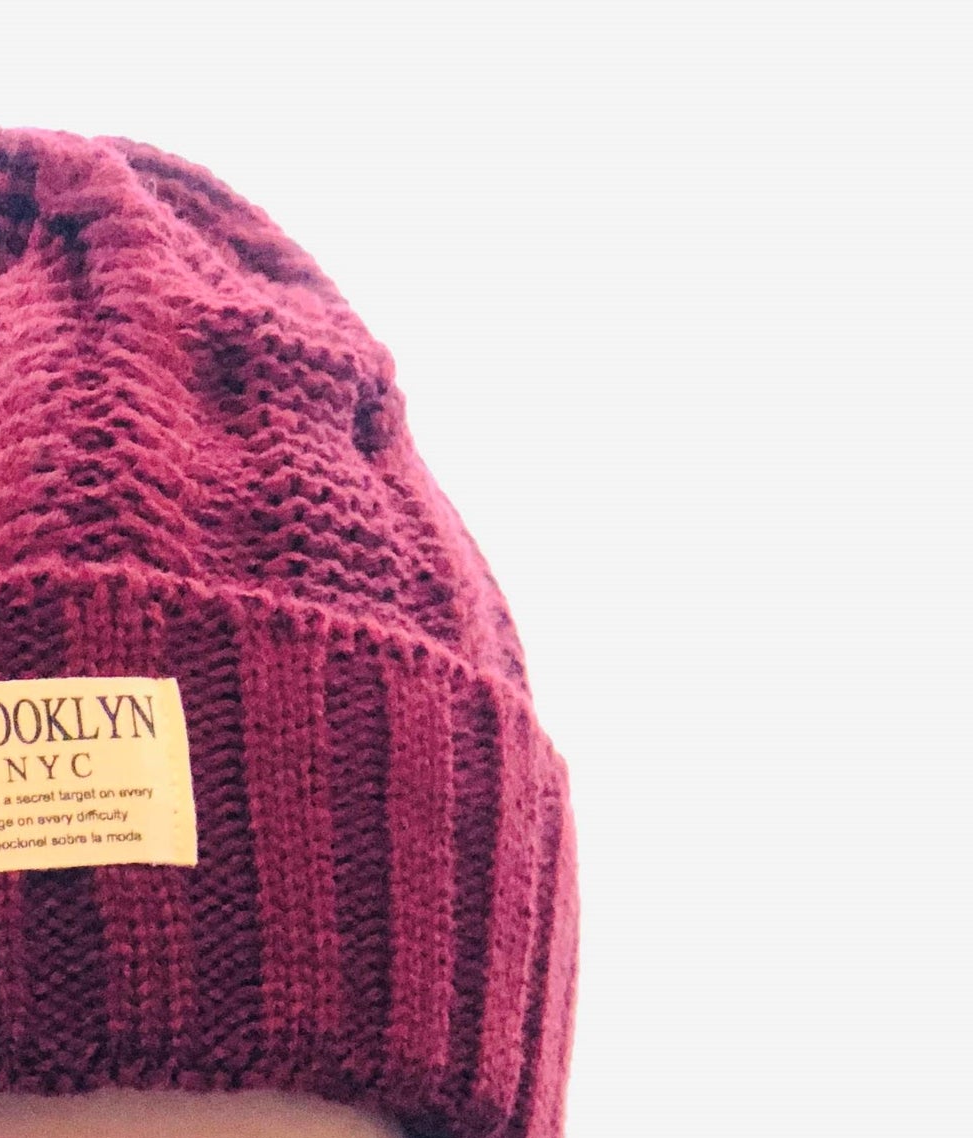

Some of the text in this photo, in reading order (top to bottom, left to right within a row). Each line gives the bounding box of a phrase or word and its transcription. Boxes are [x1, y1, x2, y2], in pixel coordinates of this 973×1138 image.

[3, 752, 93, 783] NYC
[3, 796, 11, 806] a
[16, 790, 55, 805] secret
[59, 788, 96, 803] target
[99, 789, 115, 799] on
[119, 787, 153, 799] every
[17, 816, 34, 827] on
[37, 813, 73, 825] every
[76, 808, 129, 823] difficulty
[51, 834, 87, 846] sobre
[91, 831, 102, 843] la
[106, 829, 143, 843] moda
